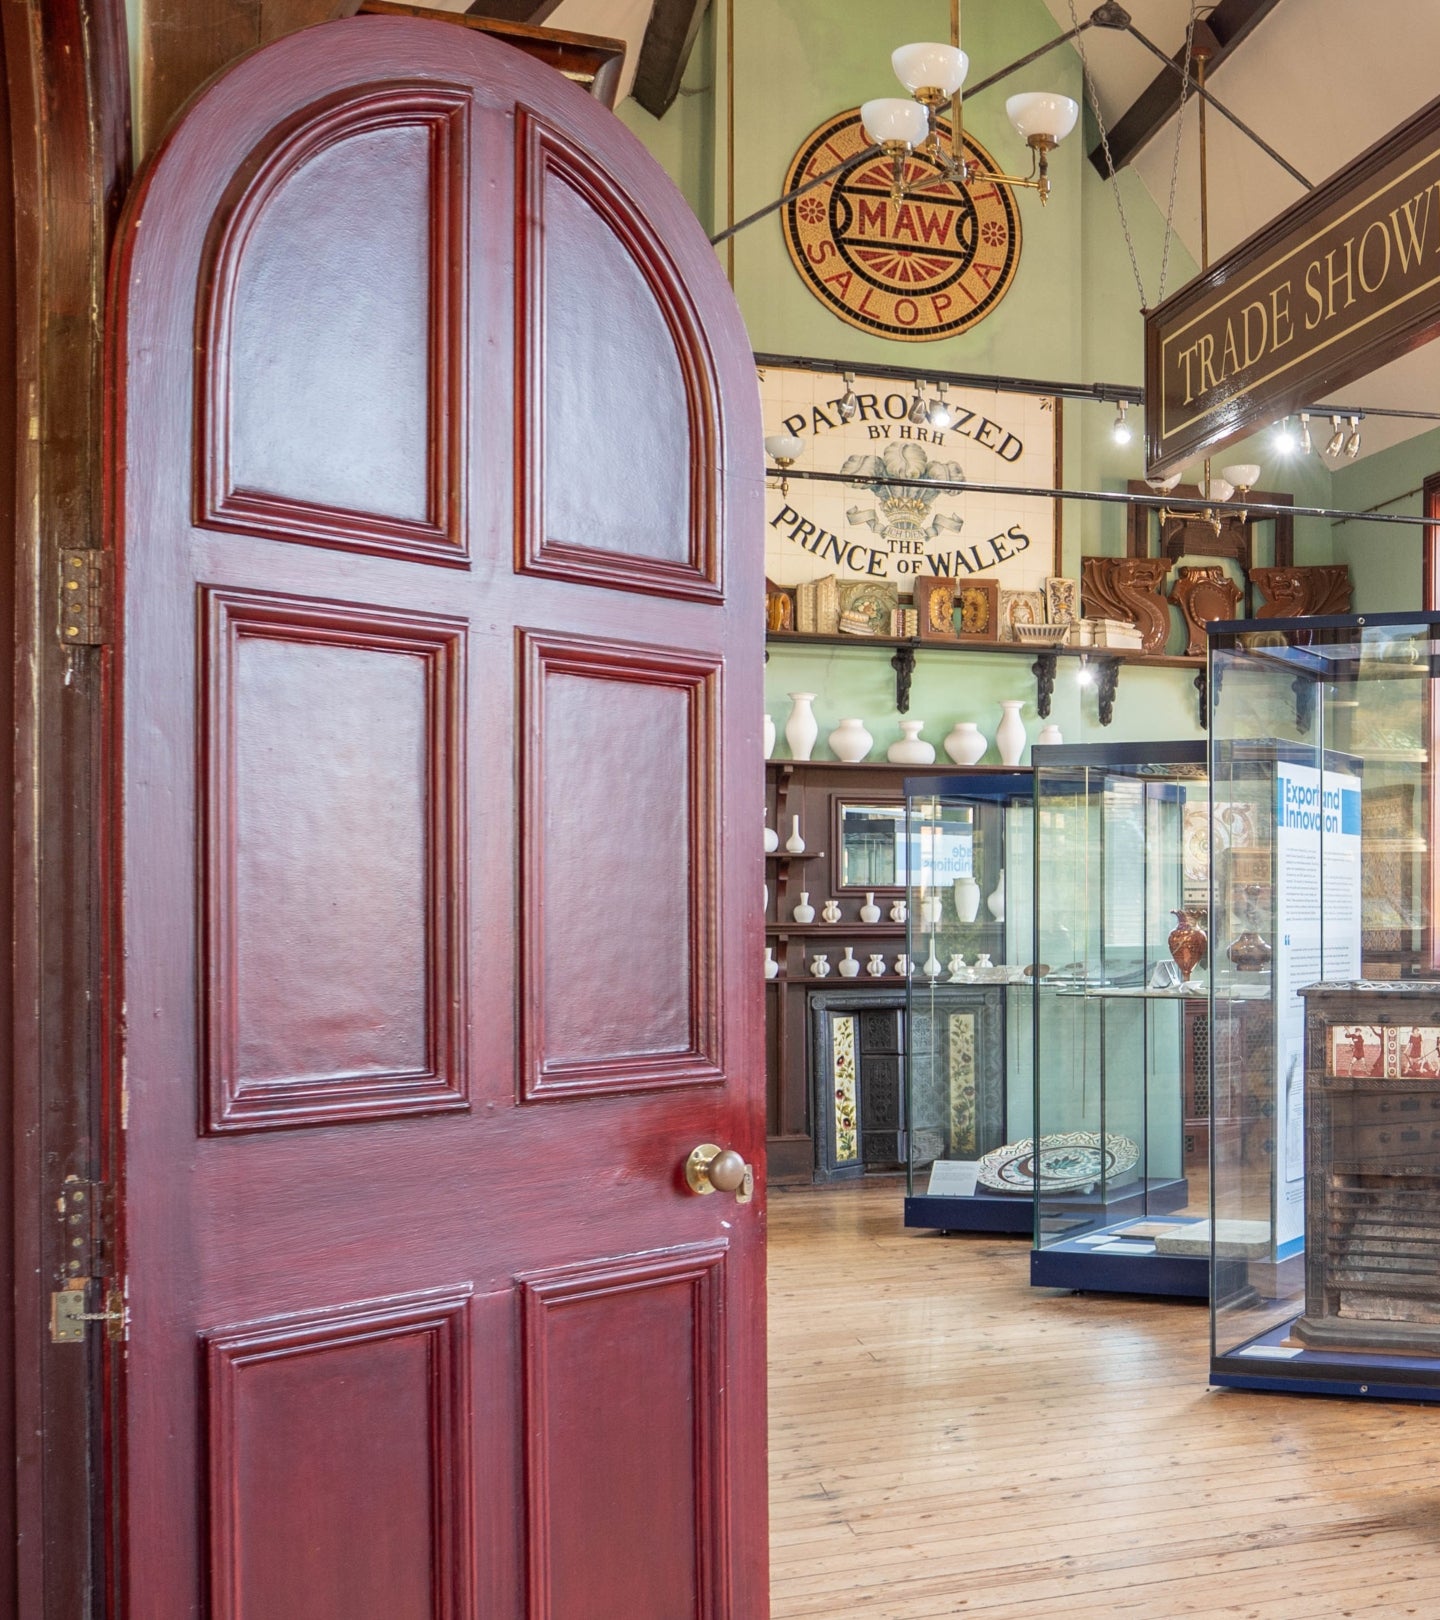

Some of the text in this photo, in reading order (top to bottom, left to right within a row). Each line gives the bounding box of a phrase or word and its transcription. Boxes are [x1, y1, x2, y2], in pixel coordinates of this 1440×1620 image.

[858, 198, 955, 245] MAW
[806, 239, 1002, 326] SALOPIA
[1177, 280, 1294, 407] TRADE
[868, 425, 891, 440] BY
[768, 503, 1031, 578] PRINCE OF WALES
[887, 540, 923, 554] THE
